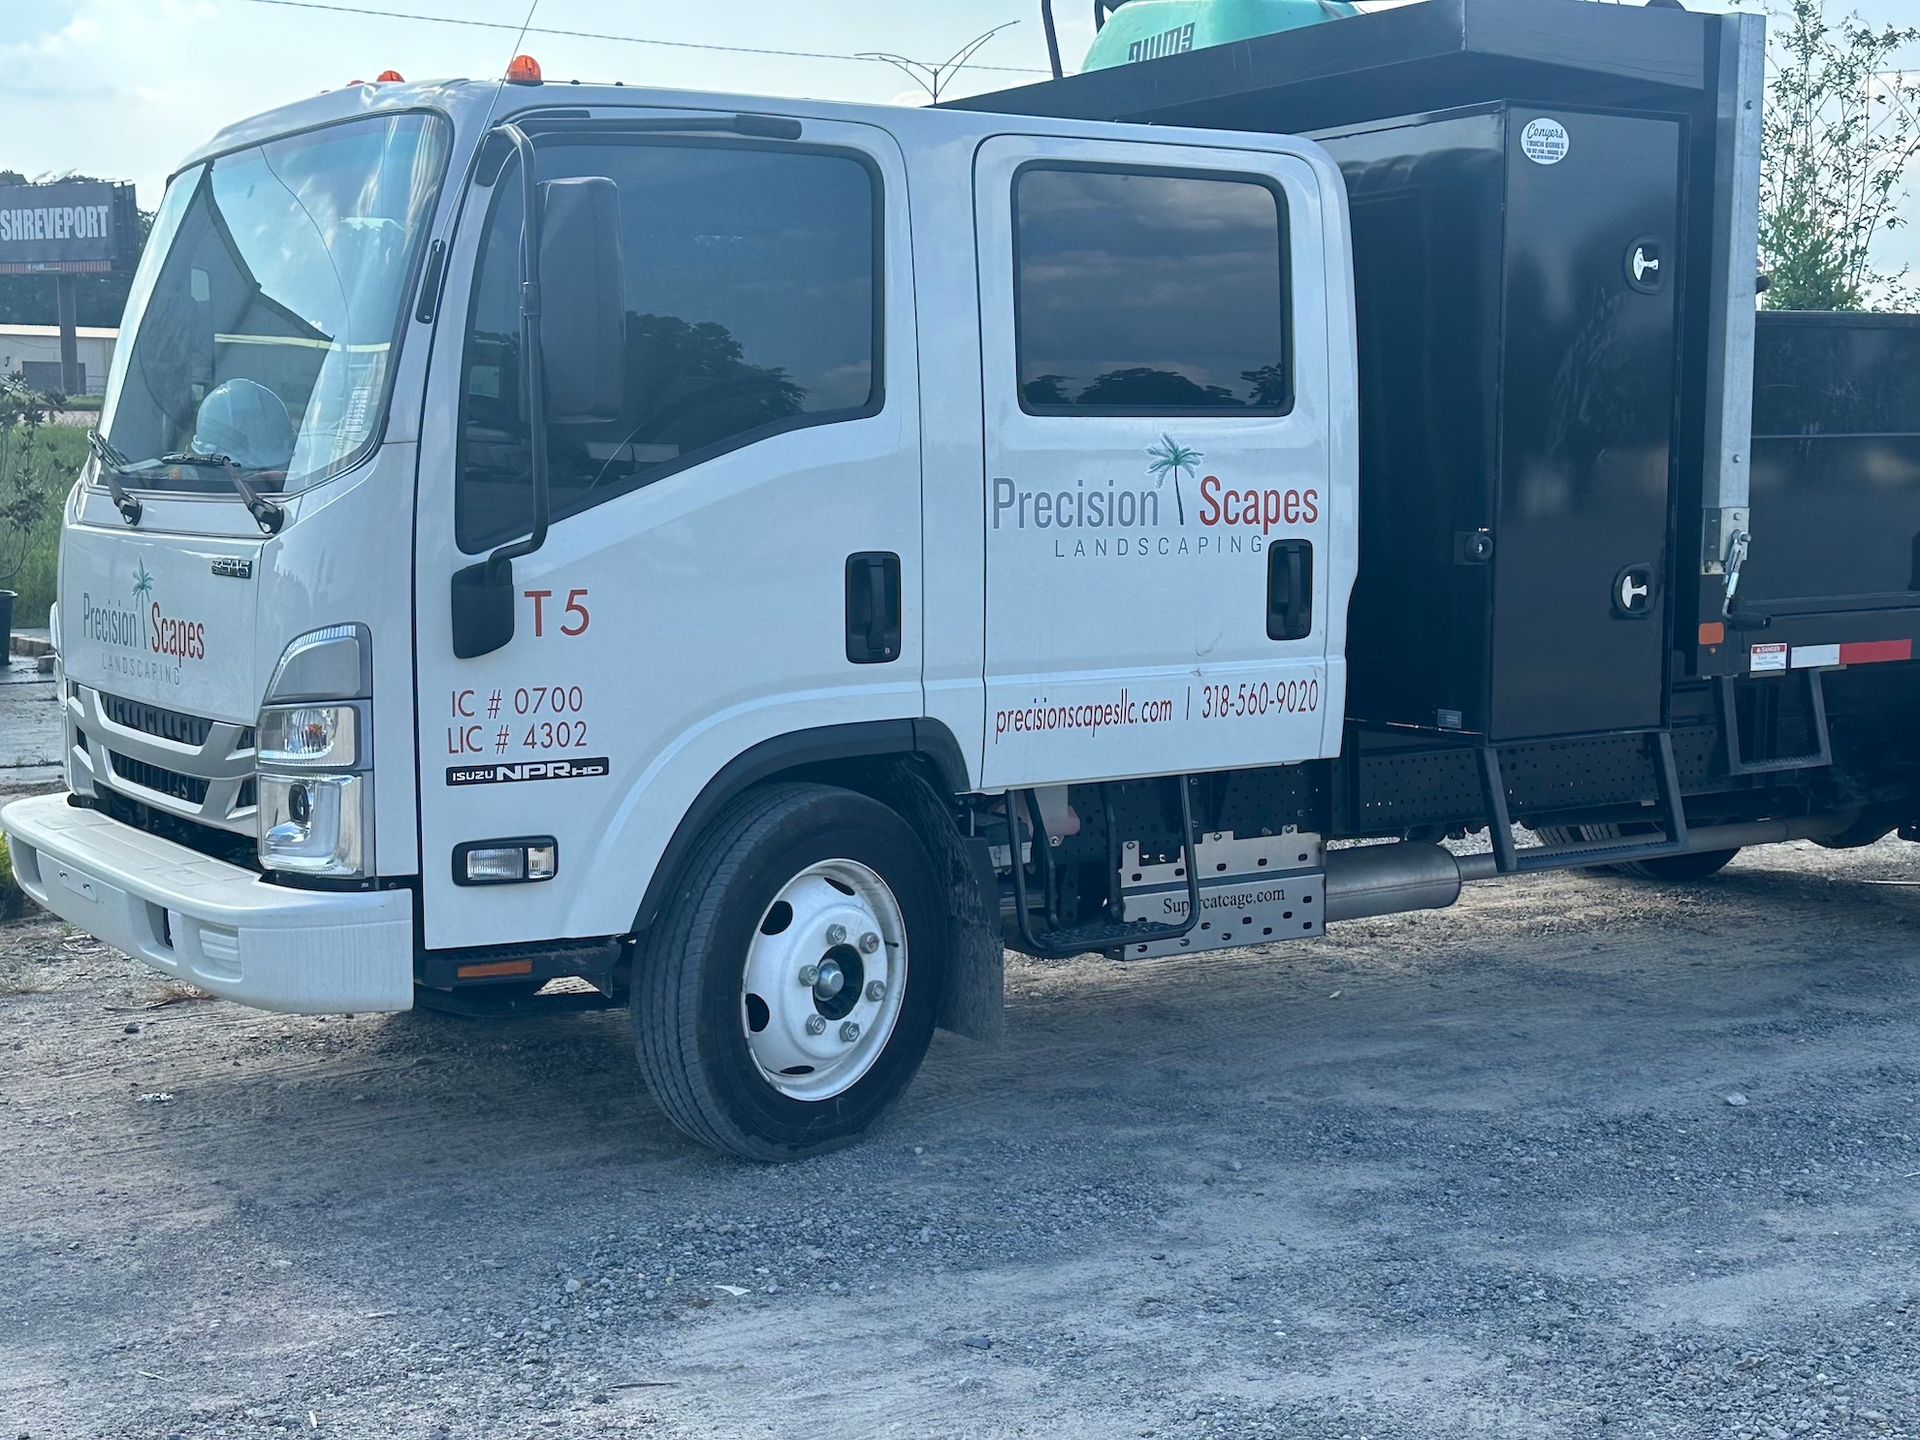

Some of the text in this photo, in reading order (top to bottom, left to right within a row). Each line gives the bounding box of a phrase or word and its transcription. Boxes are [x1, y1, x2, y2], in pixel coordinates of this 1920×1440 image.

[1527, 123, 1563, 140] Conyers
[0, 205, 109, 241] SHREVEPORT
[992, 475, 1319, 535] Precision Scapes
[1055, 535, 1263, 558] LANDSCAPING
[83, 592, 205, 668] Precision Scapes
[102, 653, 181, 686] LANDSCAPING
[452, 686, 583, 720] IC # 0700
[995, 687, 1173, 745] precisionscapesllc.com
[1202, 679, 1319, 719] 318-560-9020
[447, 720, 588, 755] LIC # 4302
[452, 769, 494, 782] ISUZU
[1163, 888, 1285, 916] Suprcatcage.com
